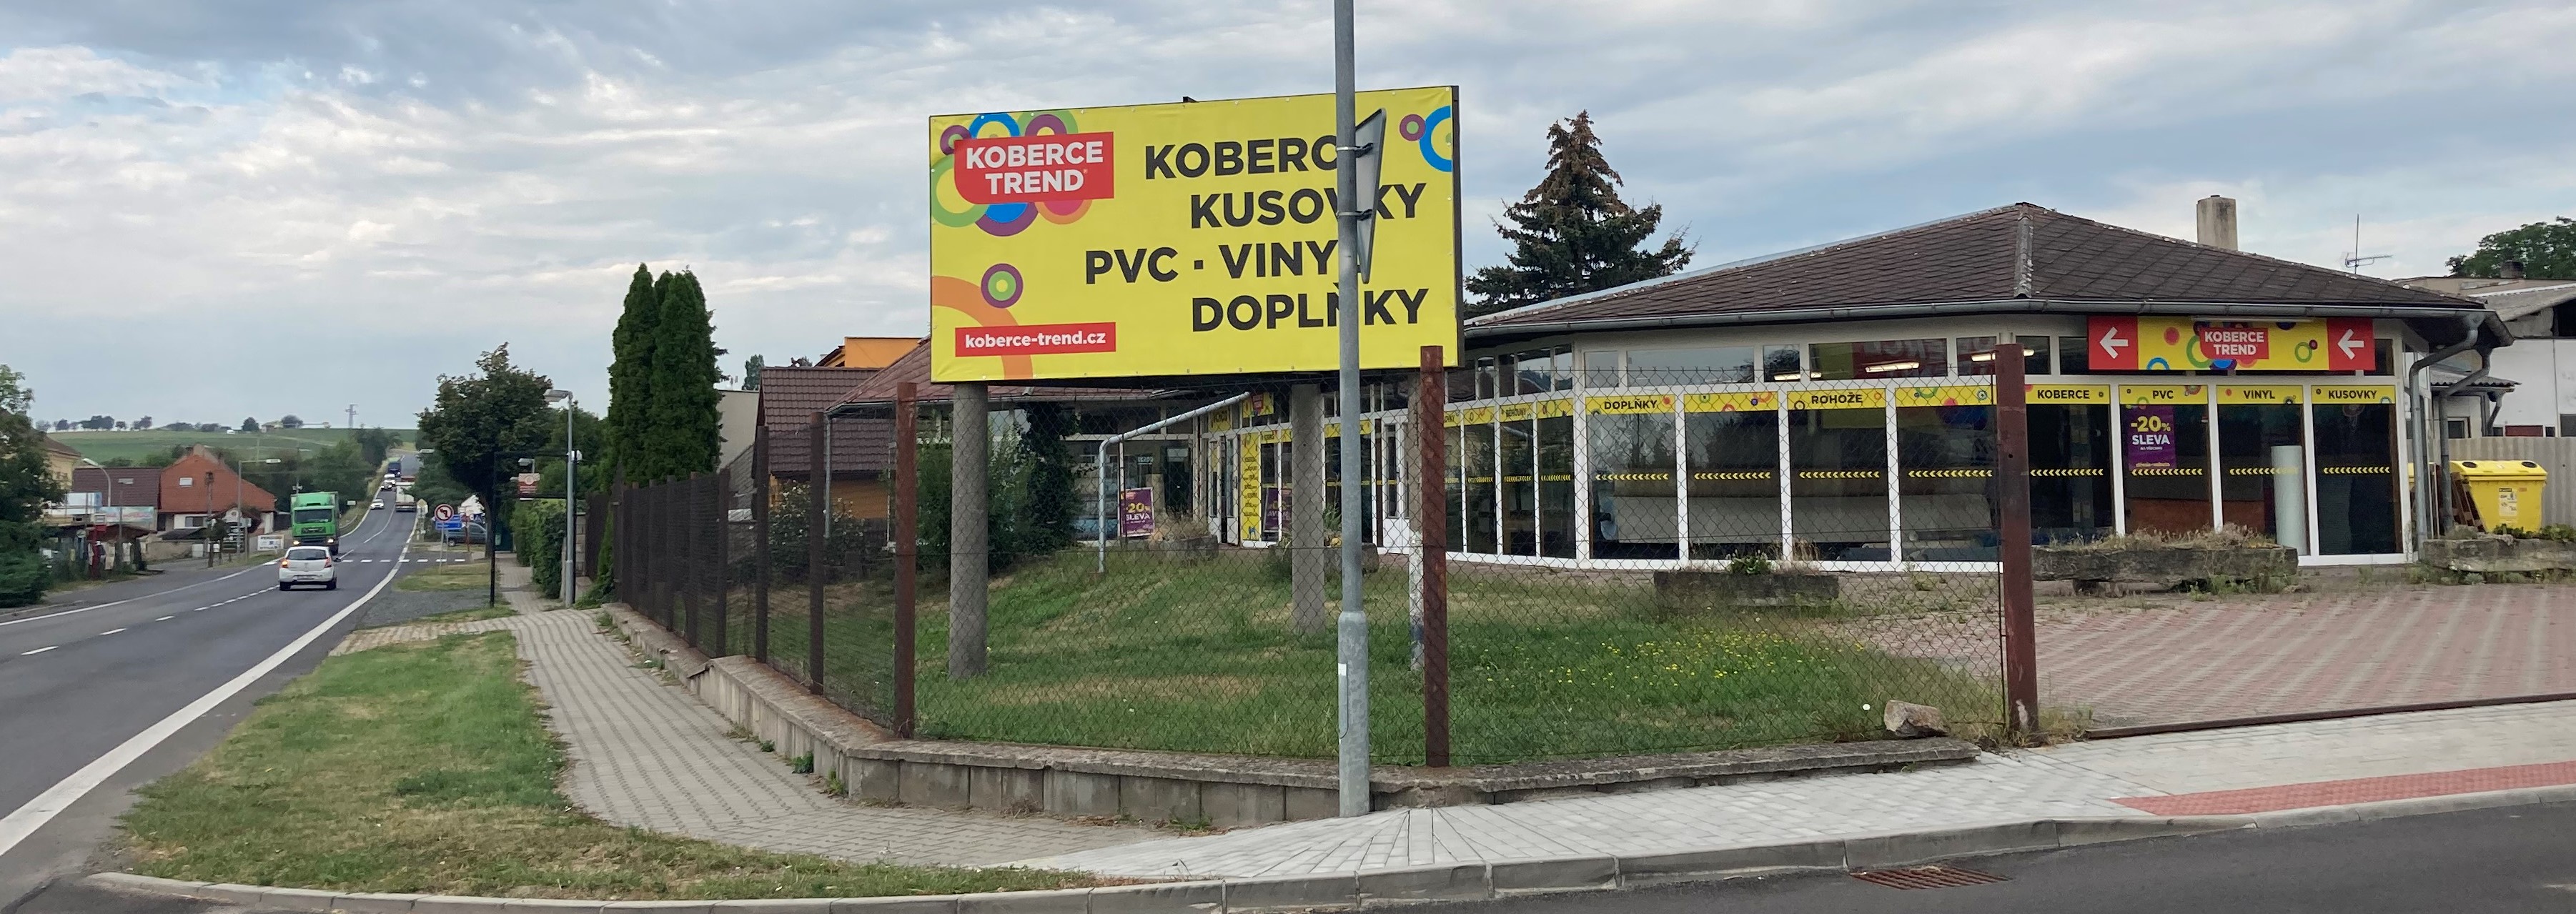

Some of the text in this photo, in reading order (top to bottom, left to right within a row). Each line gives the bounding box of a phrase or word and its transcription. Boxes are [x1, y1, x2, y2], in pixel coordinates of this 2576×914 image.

[966, 140, 1104, 170] KOBERCE
[1145, 135, 1337, 180] KOBERC
[984, 169, 1085, 195] TREND
[1086, 239, 1340, 284] PVC VINY
[965, 330, 1106, 349] koberce-trend.cz
[2204, 330, 2264, 343] KOBERCE
[2213, 344, 2257, 355] TREND
[1810, 392, 1863, 404] ROHOŽE
[2036, 389, 2090, 399] KOBERCE
[2152, 389, 2174, 399] PVC
[2243, 389, 2276, 399] VINYL
[2328, 389, 2377, 399] KUSOVKY
[1604, 397, 1658, 409] DOPLŇKY
[2131, 416, 2171, 432] -20%
[2131, 434, 2171, 445] SLEVA
